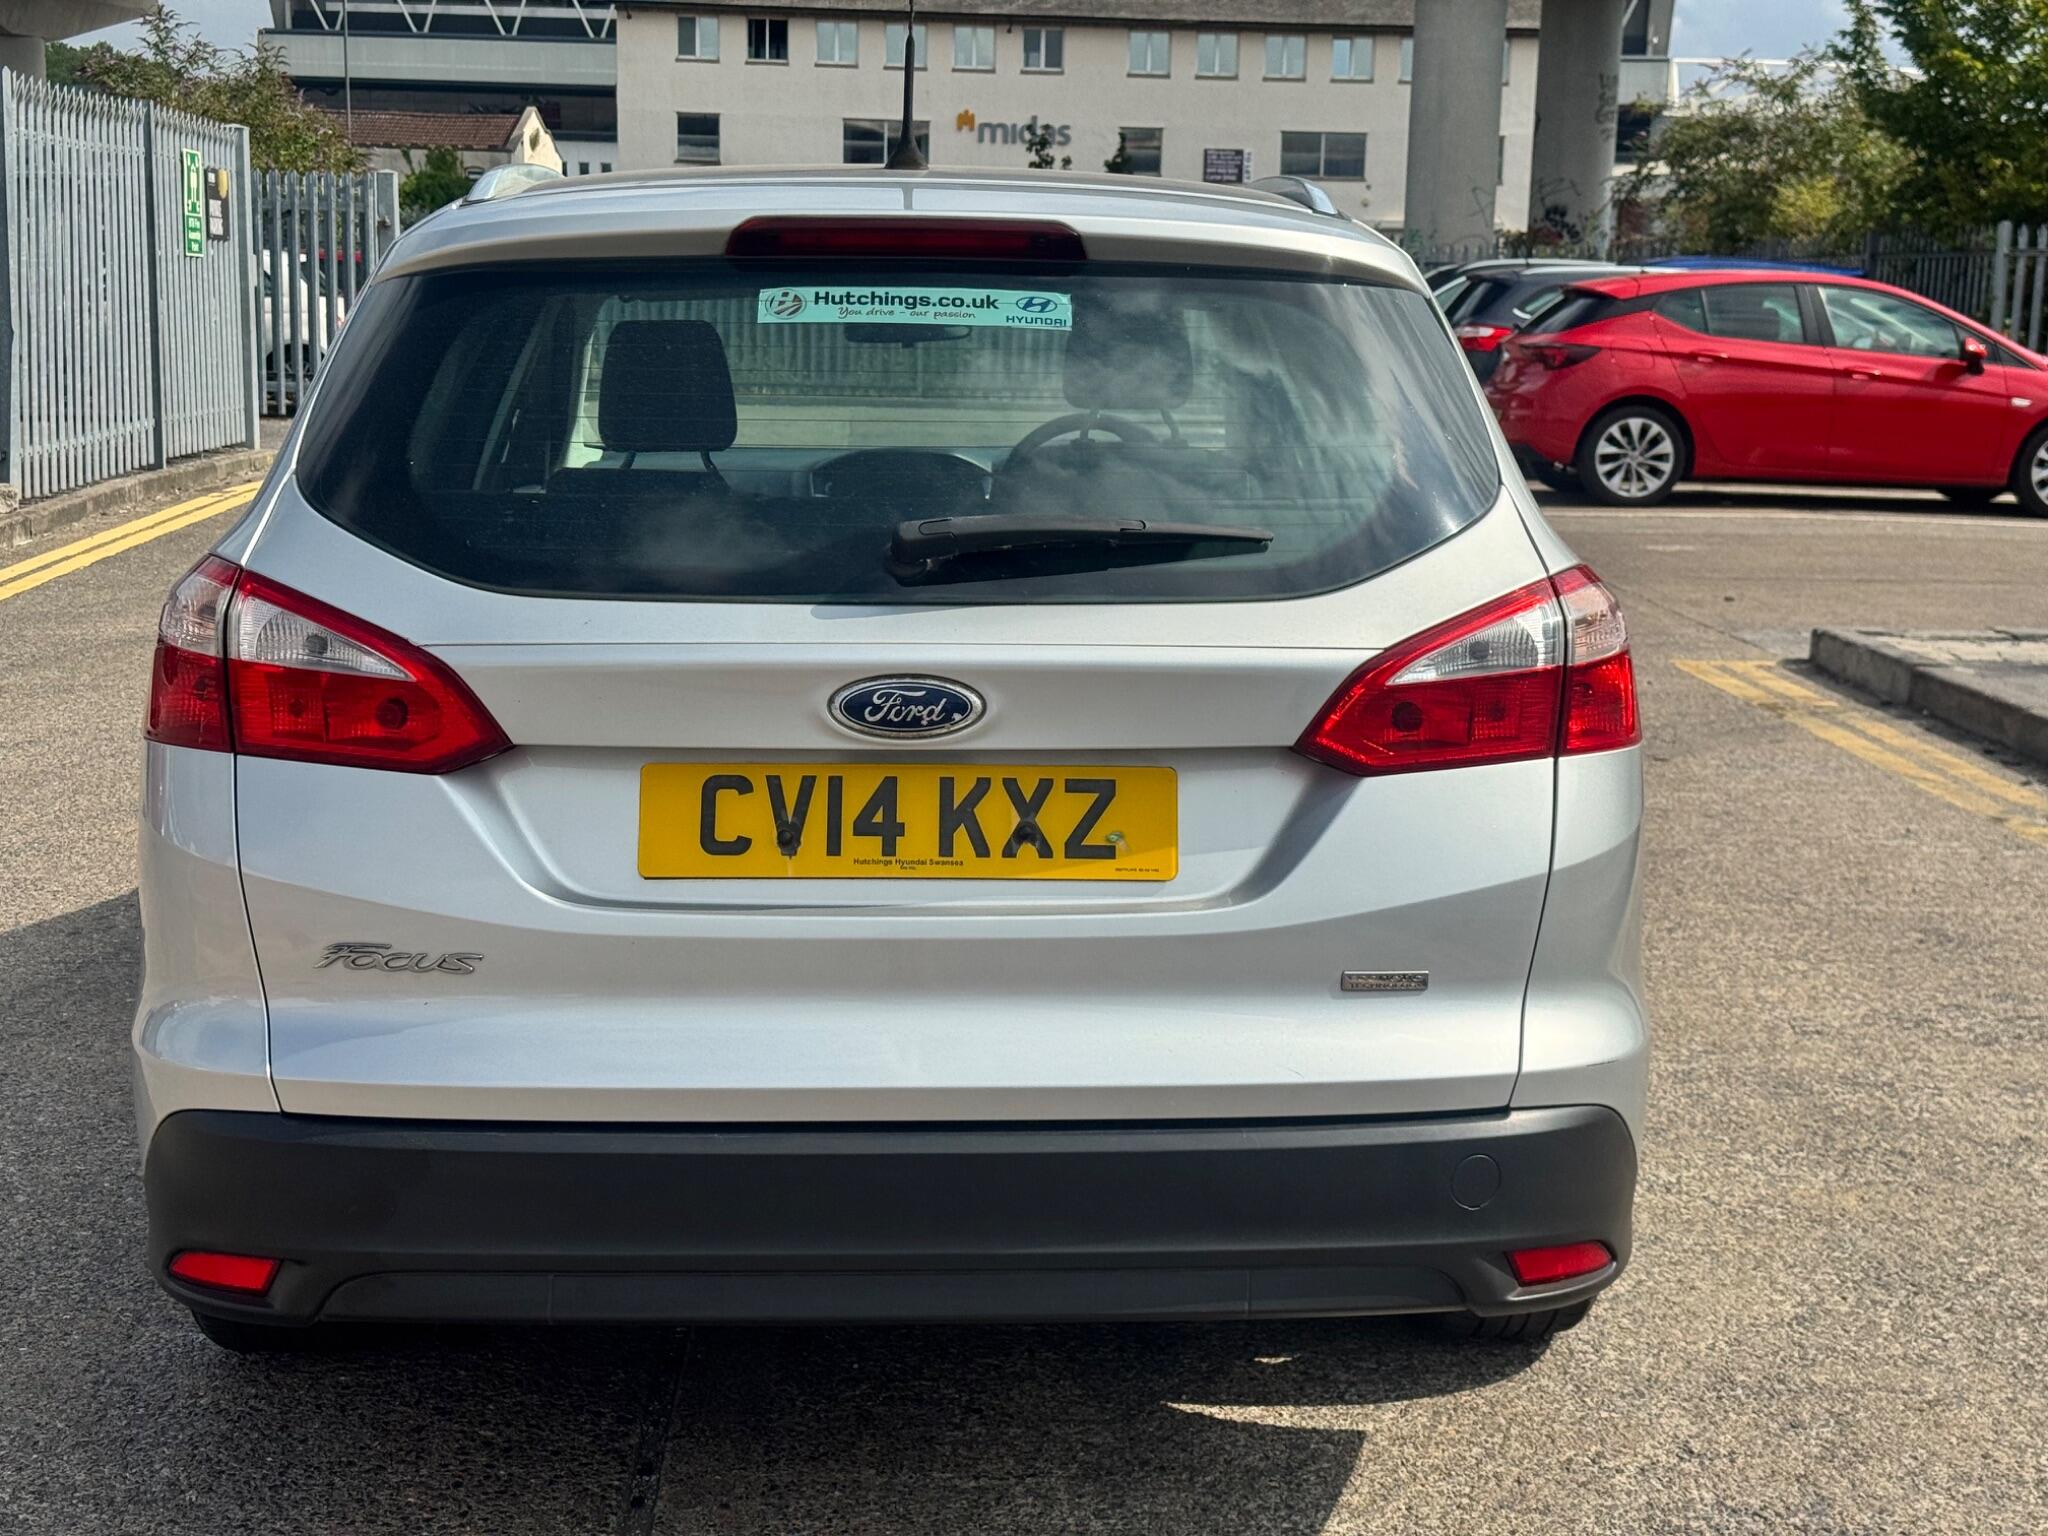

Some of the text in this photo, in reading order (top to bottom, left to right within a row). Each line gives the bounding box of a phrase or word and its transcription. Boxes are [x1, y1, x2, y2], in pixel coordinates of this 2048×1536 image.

[814, 291, 999, 310] Hutchings.co.uk
[838, 306, 862, 319] You
[866, 307, 894, 316] drive
[933, 310, 976, 319] passion
[1006, 315, 1067, 327] HYUNDAI
[864, 689, 947, 723] Ford
[700, 775, 1116, 859] CV14 KXZ
[853, 858, 964, 867] Hutchings Hyundai Swansea
